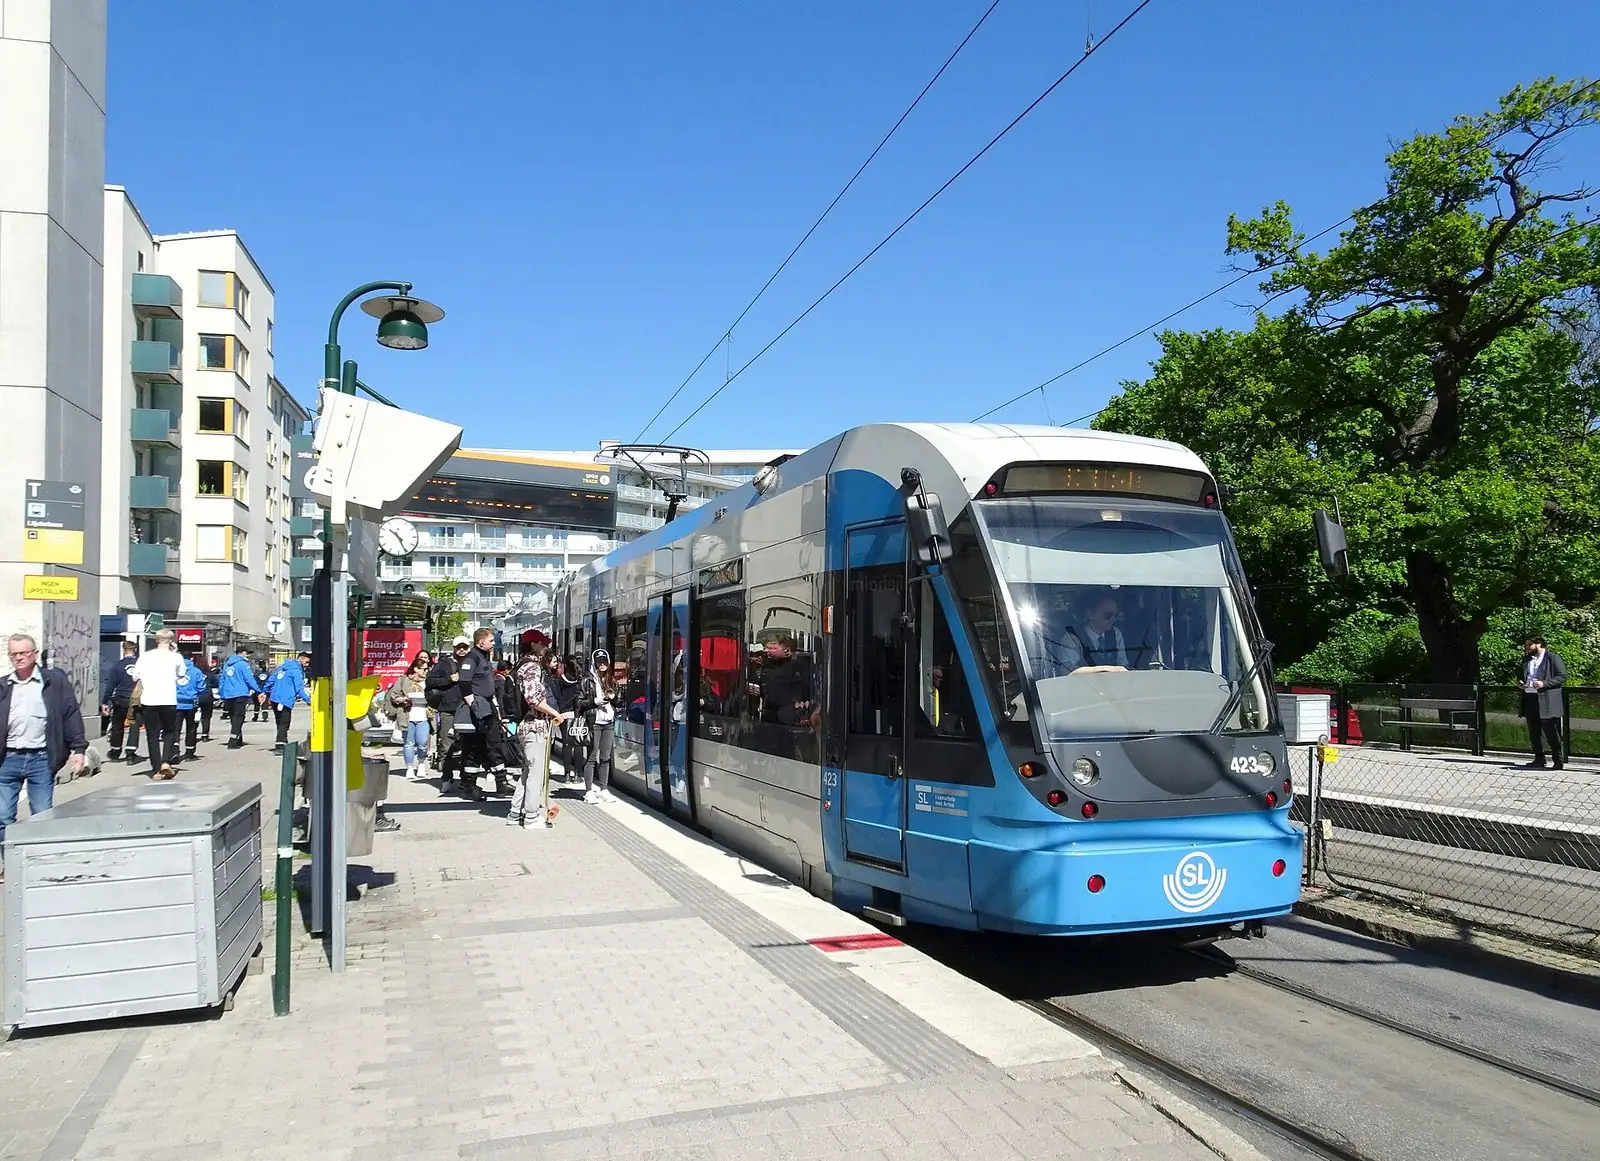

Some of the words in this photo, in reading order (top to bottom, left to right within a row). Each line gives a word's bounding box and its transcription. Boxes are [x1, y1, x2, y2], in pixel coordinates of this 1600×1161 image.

[27, 482, 42, 498] T
[271, 621, 281, 632] T
[1230, 756, 1258, 774] 423
[823, 772, 837, 787] 423
[918, 792, 929, 805] SL
[1182, 863, 1208, 887] SL
